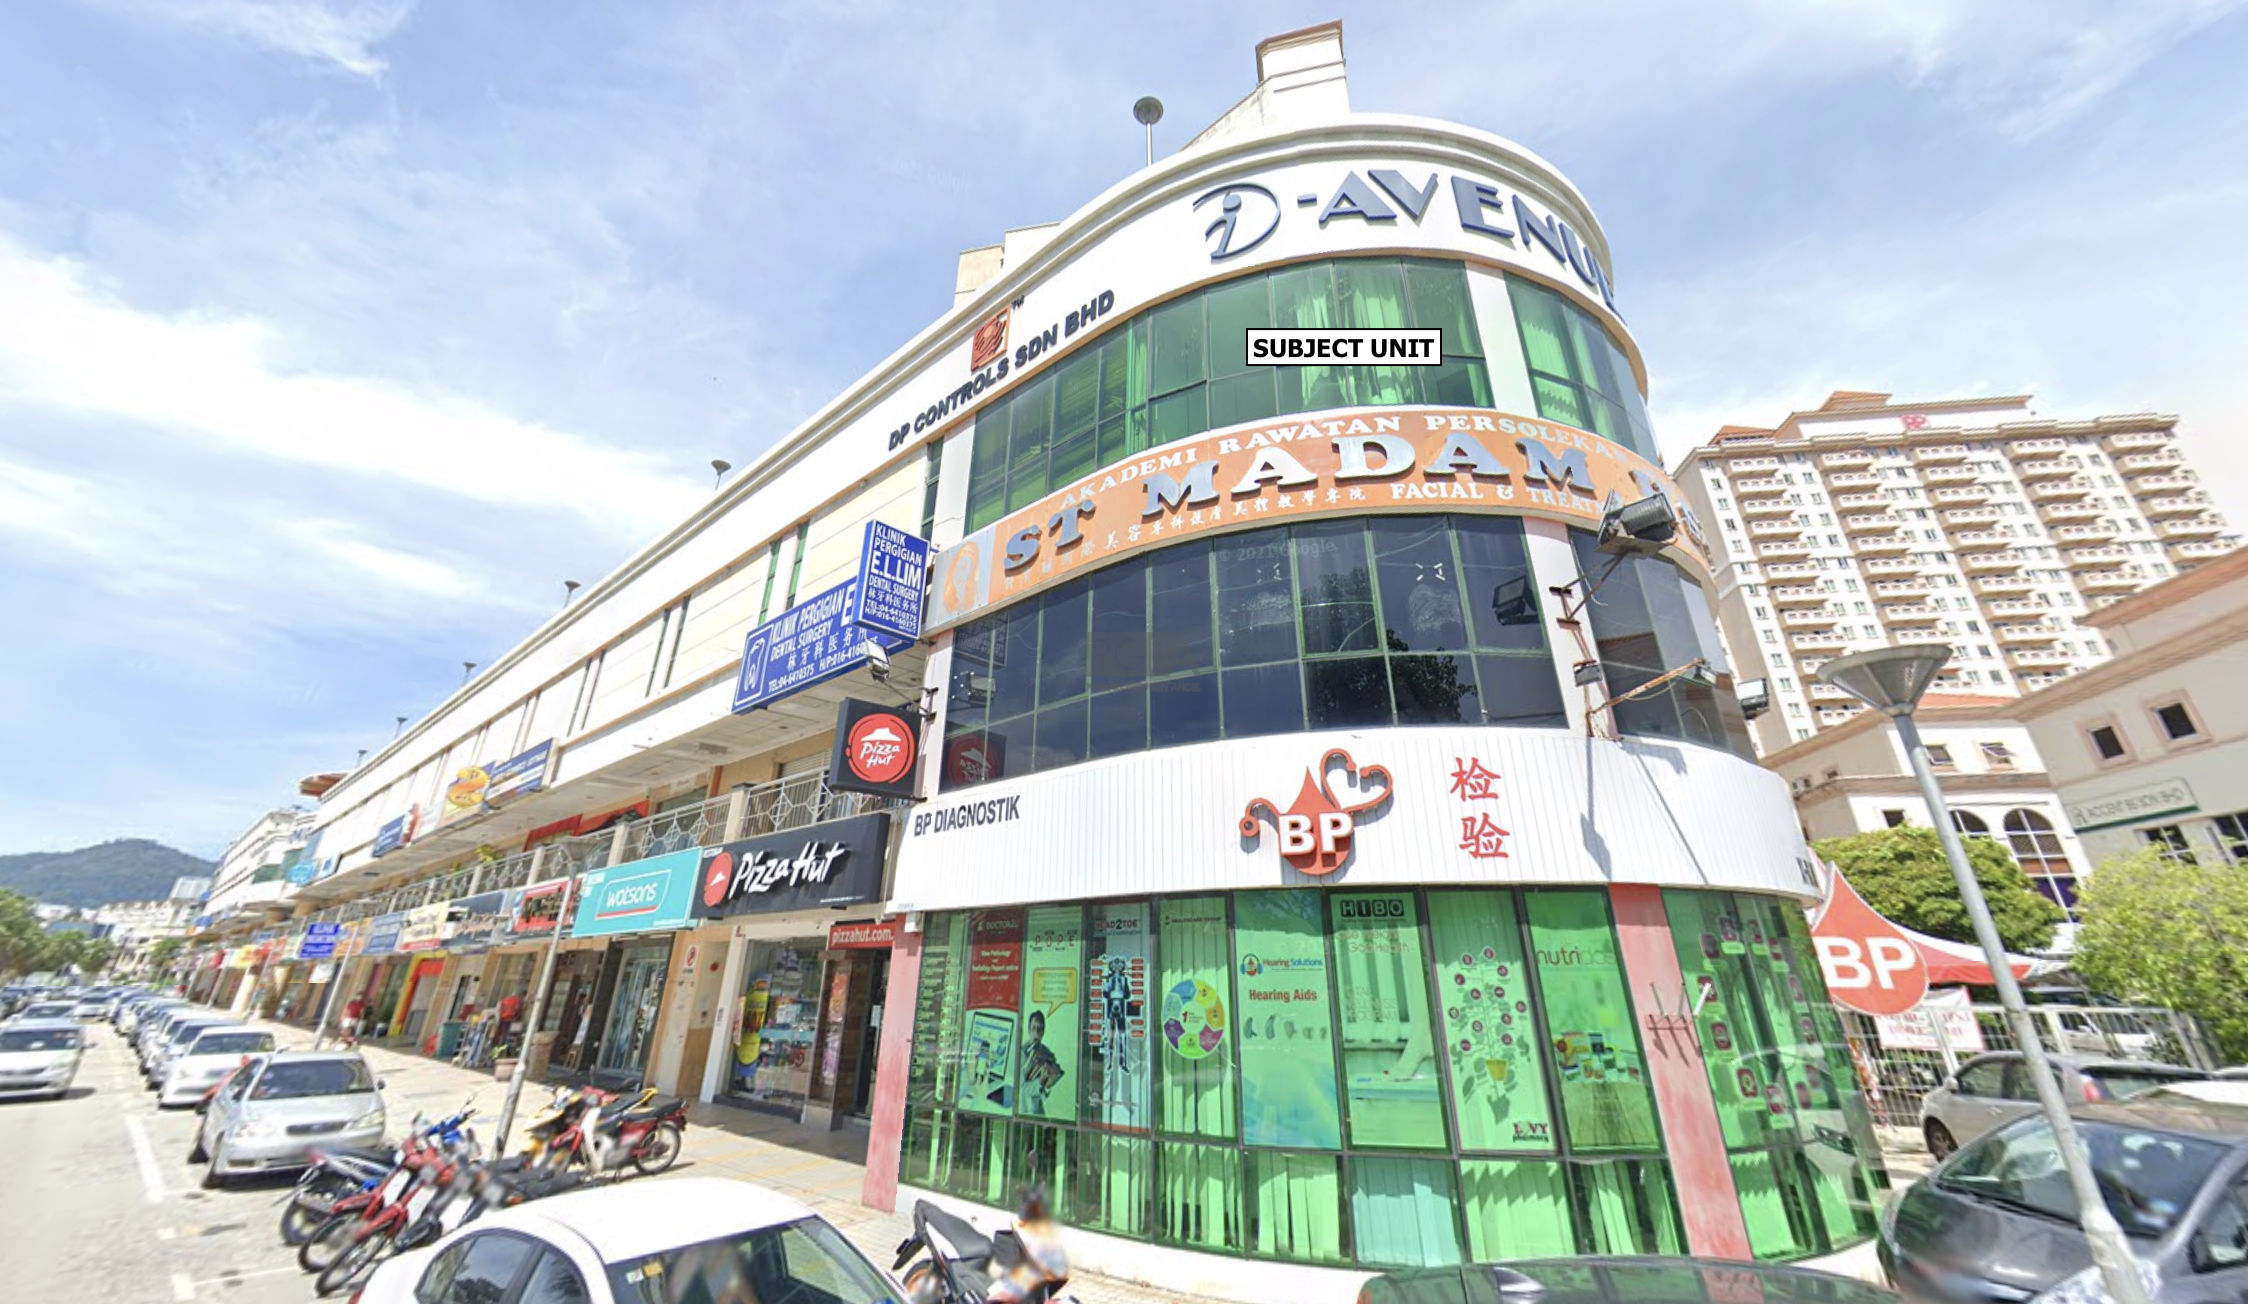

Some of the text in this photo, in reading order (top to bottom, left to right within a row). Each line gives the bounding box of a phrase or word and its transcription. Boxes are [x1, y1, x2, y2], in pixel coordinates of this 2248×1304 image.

[889, 289, 1116, 451] DP CONTROLS SDN BHD
[1060, 447, 1197, 509] AKADEMI
[1218, 416, 1400, 455] RAWATAN
[1003, 499, 1097, 571] ST
[1142, 431, 1597, 518] MADAM
[1391, 482, 1484, 500] FACIAL
[1497, 484, 1514, 500] &
[874, 538, 923, 567] PERGIGIAN
[876, 524, 907, 547] KLINIK
[868, 574, 919, 601] DENTAL SURGERY
[870, 550, 922, 591] E.L.LIM
[771, 611, 800, 646] KLINIK
[800, 588, 846, 632] PERGIGIAN
[770, 620, 834, 663] DENTAL SURGERY
[860, 740, 901, 760] Pizza
[866, 753, 894, 769] Hut
[914, 795, 1021, 837] BP DIAGNOSTIK
[1450, 756, 1510, 860] 检验
[1277, 811, 1354, 857] BP
[728, 840, 845, 899] Pizza Hut
[606, 882, 658, 909] watsons
[1342, 901, 1404, 916] HIBO
[1263, 958, 1323, 968] Hearing Solutions
[1813, 936, 1916, 989] BP
[1249, 989, 1318, 1003] Hearing Aids
